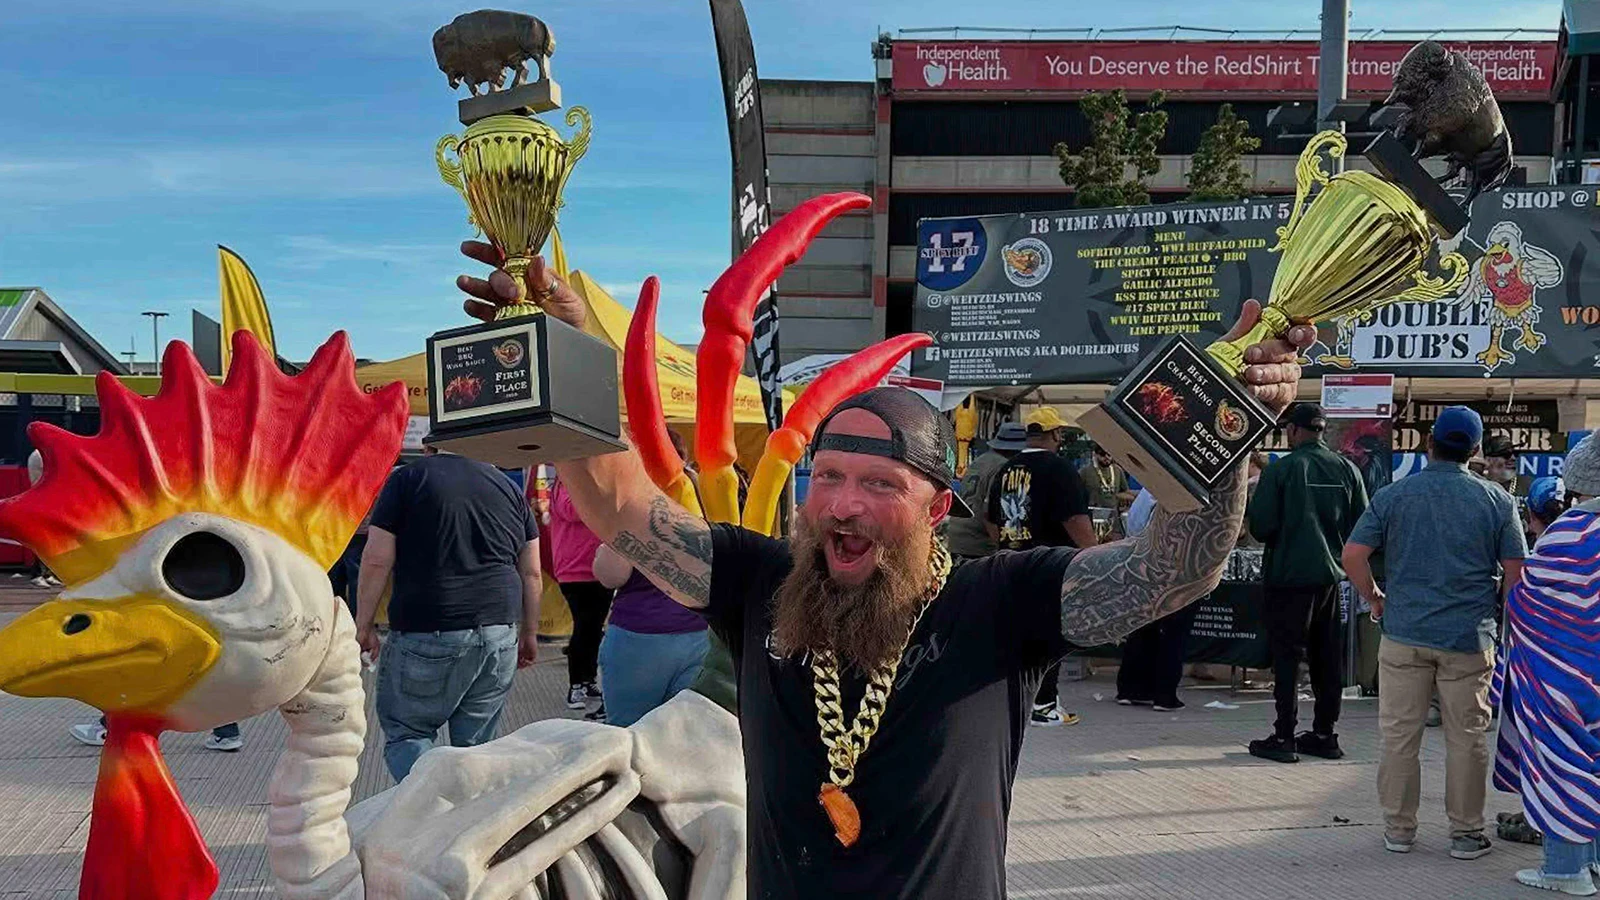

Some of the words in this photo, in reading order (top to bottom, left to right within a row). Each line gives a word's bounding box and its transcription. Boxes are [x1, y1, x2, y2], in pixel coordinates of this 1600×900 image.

[916, 45, 1000, 61] Independent
[1449, 45, 1536, 65] dependent
[949, 61, 1008, 81] Health
[1045, 55, 1083, 76] You
[1089, 55, 1170, 76] Deserve
[1176, 55, 1209, 75] the
[1214, 54, 1302, 76] RedShirt
[1307, 55, 1402, 75] Ttmen
[1482, 61, 1543, 80] Health
[1502, 191, 1565, 210] SHOP
[1030, 218, 1049, 235] 18
[1055, 214, 1099, 232] TIME
[1102, 210, 1168, 229] AWARD
[1172, 205, 1246, 225] WINNER
[1251, 204, 1273, 220] IN
[1277, 203, 1290, 219] 5
[1154, 231, 1186, 243] MENU
[928, 231, 974, 272] 17
[1077, 246, 1122, 259] SOFRITO
[1124, 245, 1151, 256] LOCO
[1187, 240, 1236, 251] BUFFALO
[1238, 238, 1266, 249] MILD
[1095, 259, 1115, 269] THE
[1117, 256, 1161, 268] CREAMY
[1163, 254, 1199, 266] PEACH
[1223, 252, 1247, 262] BBQ
[1121, 268, 1152, 279] SPICY
[1155, 265, 1217, 277] VEGETABLE
[1123, 279, 1162, 290] GARLIC
[1164, 277, 1213, 288] ALFREDO
[1138, 291, 1157, 301] BIG
[1160, 290, 1183, 300] MAC
[1184, 288, 1220, 299] SAUCE
[1124, 303, 1144, 313] #17
[1146, 302, 1179, 313] SPICY
[1180, 300, 1208, 310] BLEU
[1142, 313, 1190, 324] BUFFALO
[1192, 312, 1223, 322] XHOT
[1129, 325, 1156, 336] LIME
[1157, 324, 1200, 335] PEPPER
[1033, 346, 1058, 357] AKA
[1060, 343, 1140, 355] DOUBLEDUBS
[1372, 333, 1470, 360] DUB'S
[495, 369, 526, 381] FIRST
[495, 381, 528, 394] PLACE
[1193, 421, 1232, 460] SECOND
[1187, 434, 1220, 466] PLACE
